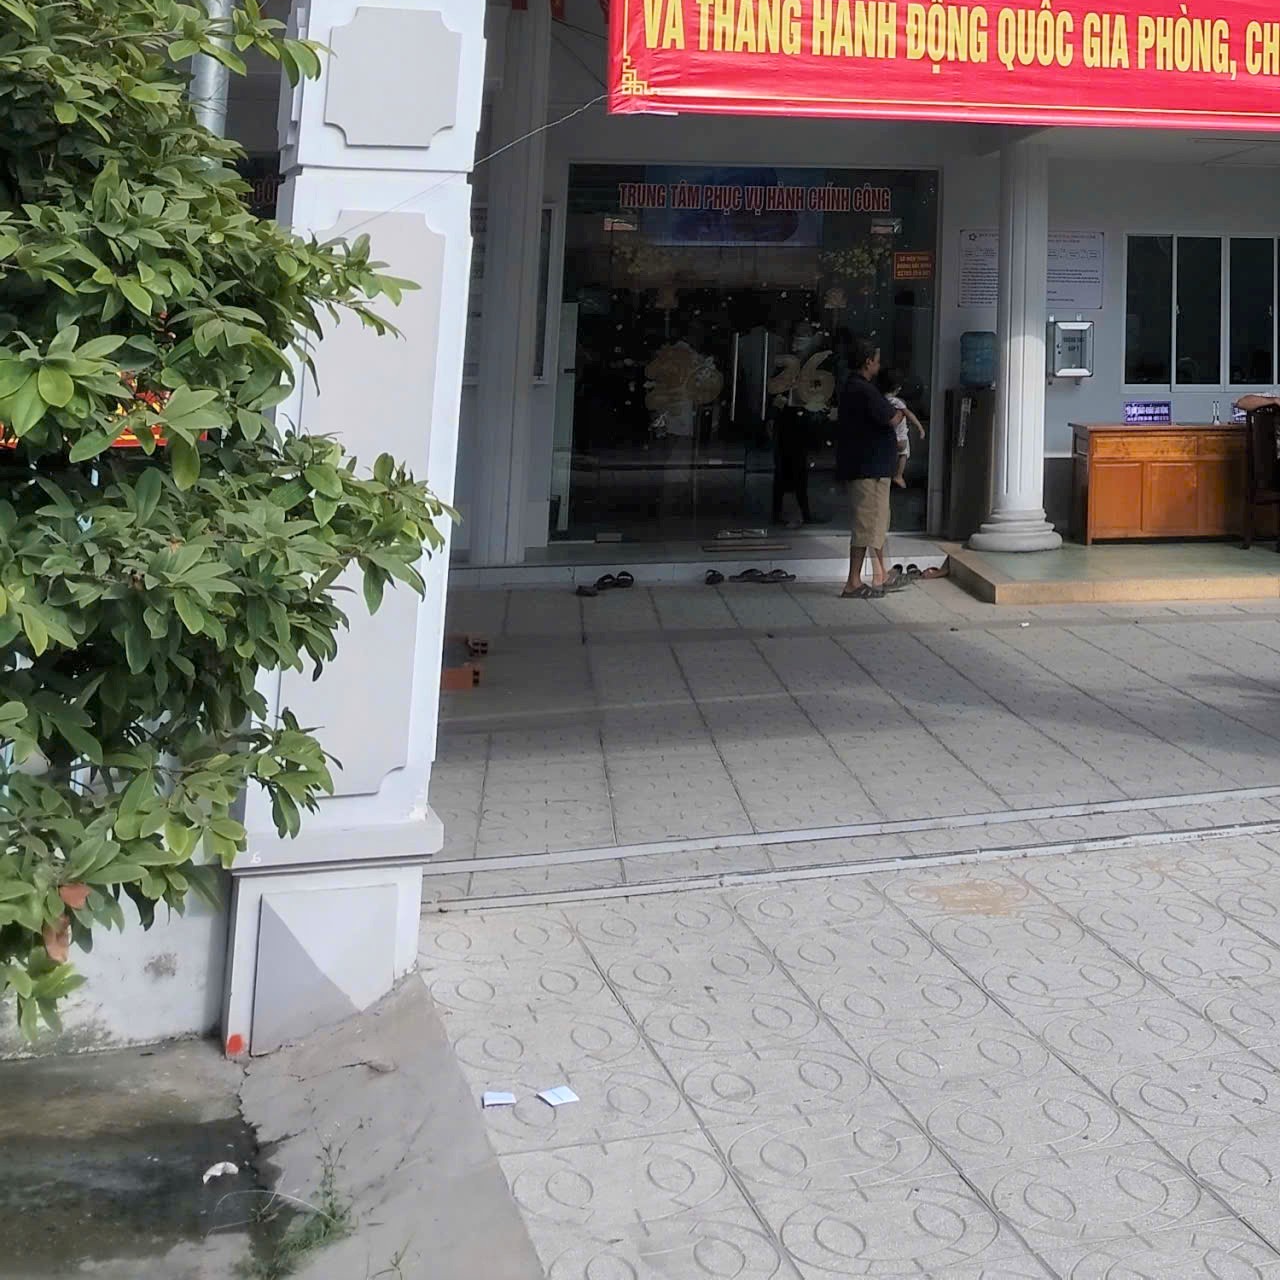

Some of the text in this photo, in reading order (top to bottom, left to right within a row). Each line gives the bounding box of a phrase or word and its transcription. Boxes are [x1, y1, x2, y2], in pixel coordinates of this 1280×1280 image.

[1083, 11, 1131, 69] GIA
[1137, 4, 1237, 81] PHÒNG,
[618, 179, 892, 216] TRUNG TÂM PHỤC VỤ HÀNH CHÍNH CÔNG
